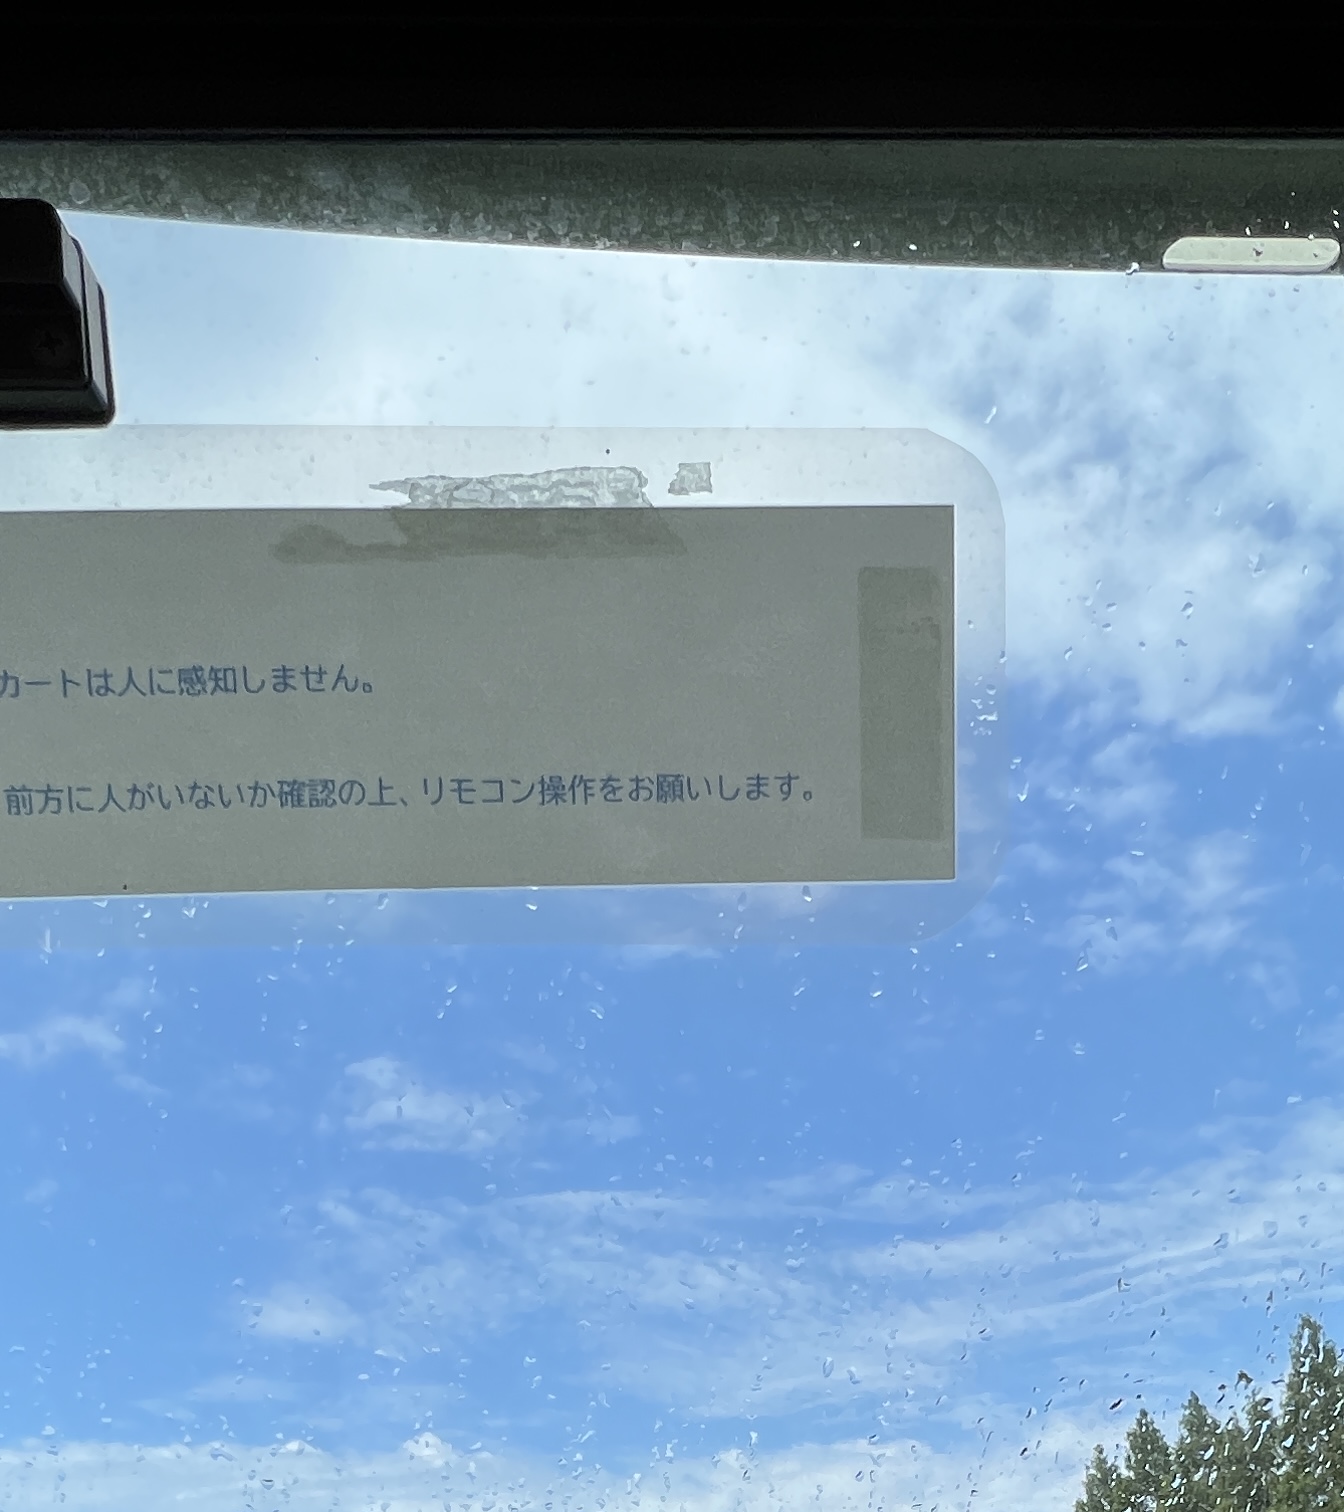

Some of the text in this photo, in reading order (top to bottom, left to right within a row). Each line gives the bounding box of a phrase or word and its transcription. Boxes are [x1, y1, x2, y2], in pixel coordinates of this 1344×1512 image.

[3, 772, 814, 816] 前方に人がいないか確認の上、リモコン操作をお願いします。
